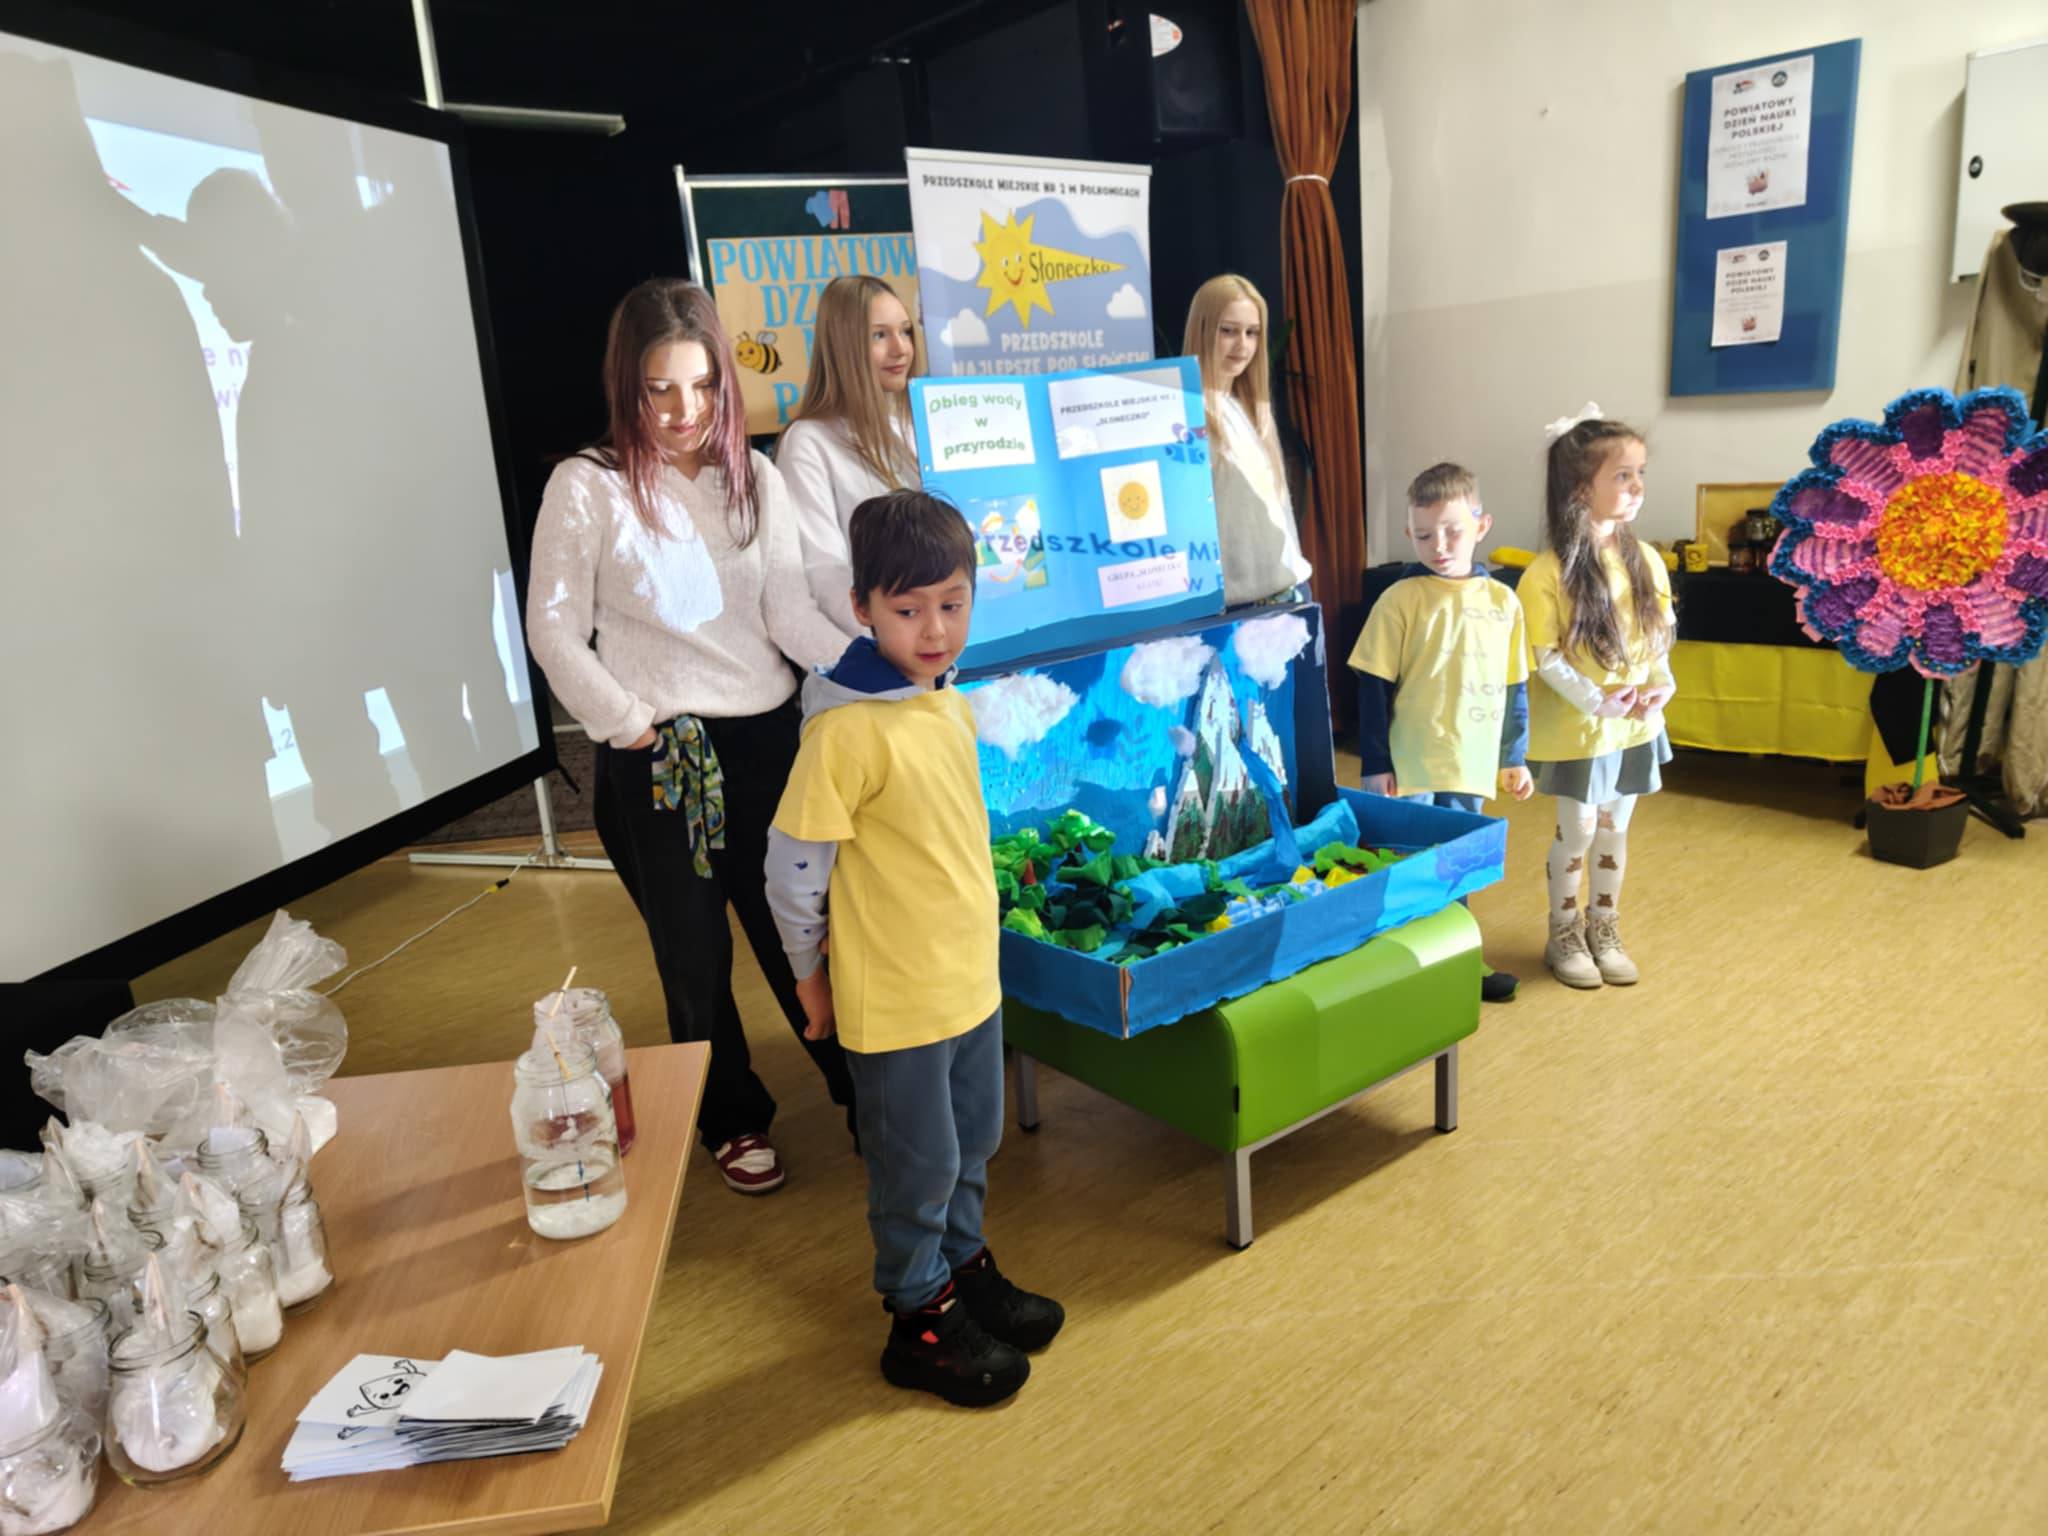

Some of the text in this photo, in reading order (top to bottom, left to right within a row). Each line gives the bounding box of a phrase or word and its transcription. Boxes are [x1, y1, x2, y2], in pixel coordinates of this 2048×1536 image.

[1724, 97, 1794, 117] POWIATOWY
[1760, 107, 1797, 122] NAUKI
[1731, 122, 1784, 139] POLSKIEJ
[922, 174, 994, 190] PRZEDSZKOLE
[711, 235, 917, 285] POWIATOW
[1029, 251, 1111, 284] Słoneczko
[1001, 329, 1105, 353] PRZEDSZKOLE
[929, 394, 1022, 413] Obieg wody
[943, 437, 1026, 460] przyrodzie
[974, 529, 1177, 561] rzedszkole
